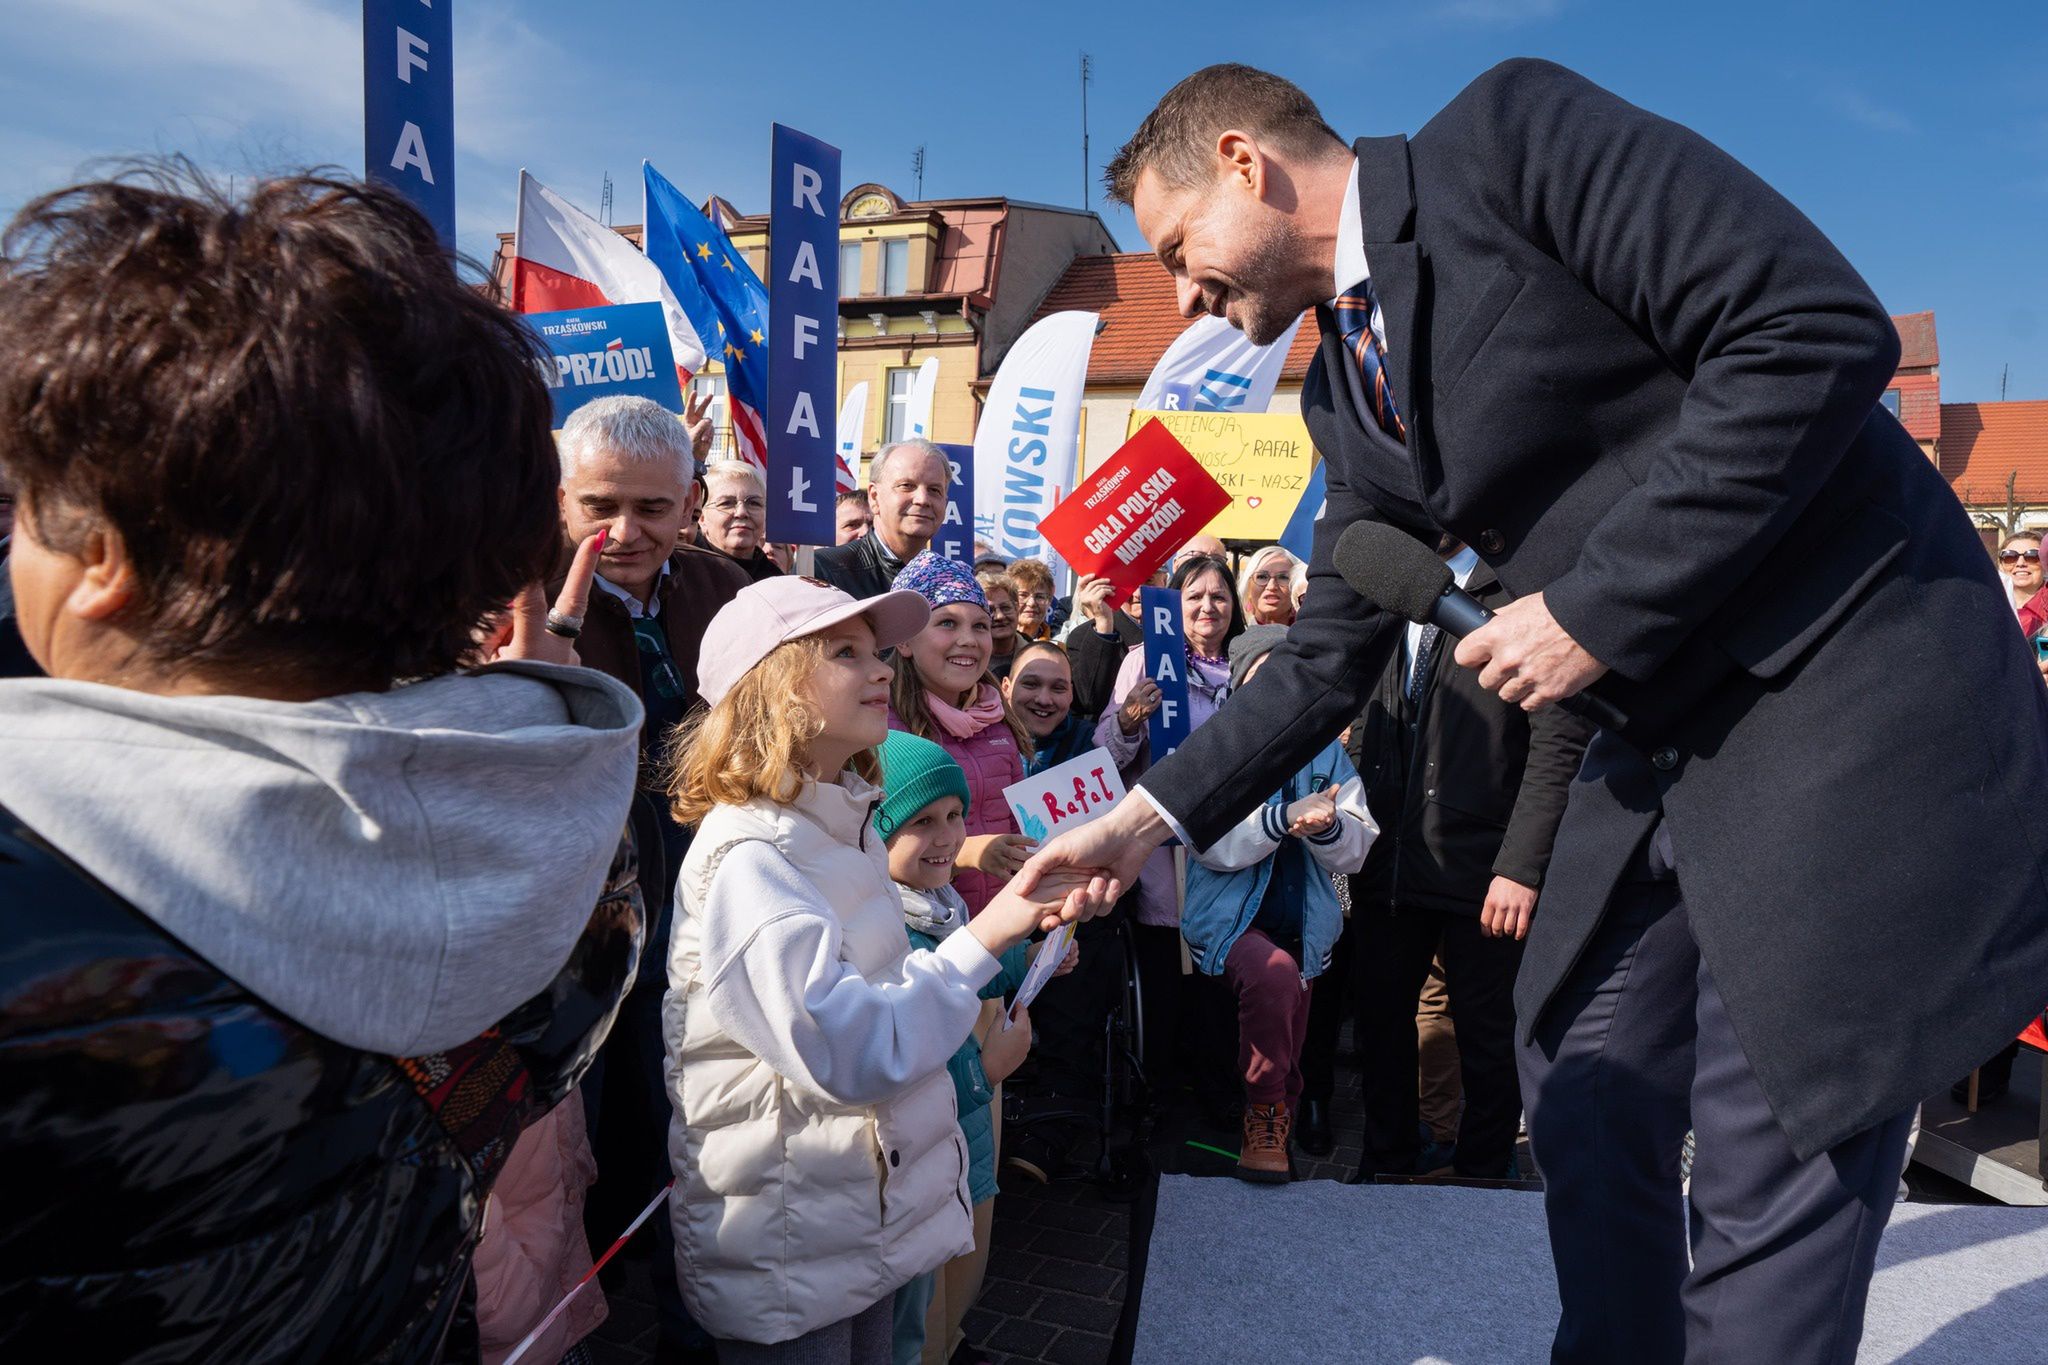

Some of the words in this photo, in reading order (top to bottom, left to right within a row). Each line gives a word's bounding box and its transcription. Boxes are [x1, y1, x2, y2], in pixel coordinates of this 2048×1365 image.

[542, 320, 607, 336] TRZASKOWSKI
[786, 162, 826, 513] RAFAŁ
[1253, 439, 1300, 458] RAFAŁ
[1084, 465, 1131, 510] TRZASKOWSKI
[1261, 474, 1304, 490] NASZ
[1083, 514, 1127, 555] CAŁA
[1117, 467, 1177, 524] POLSKA
[1113, 497, 1186, 566] NAPRZÓD!
[1153, 606, 1180, 757] RAF
